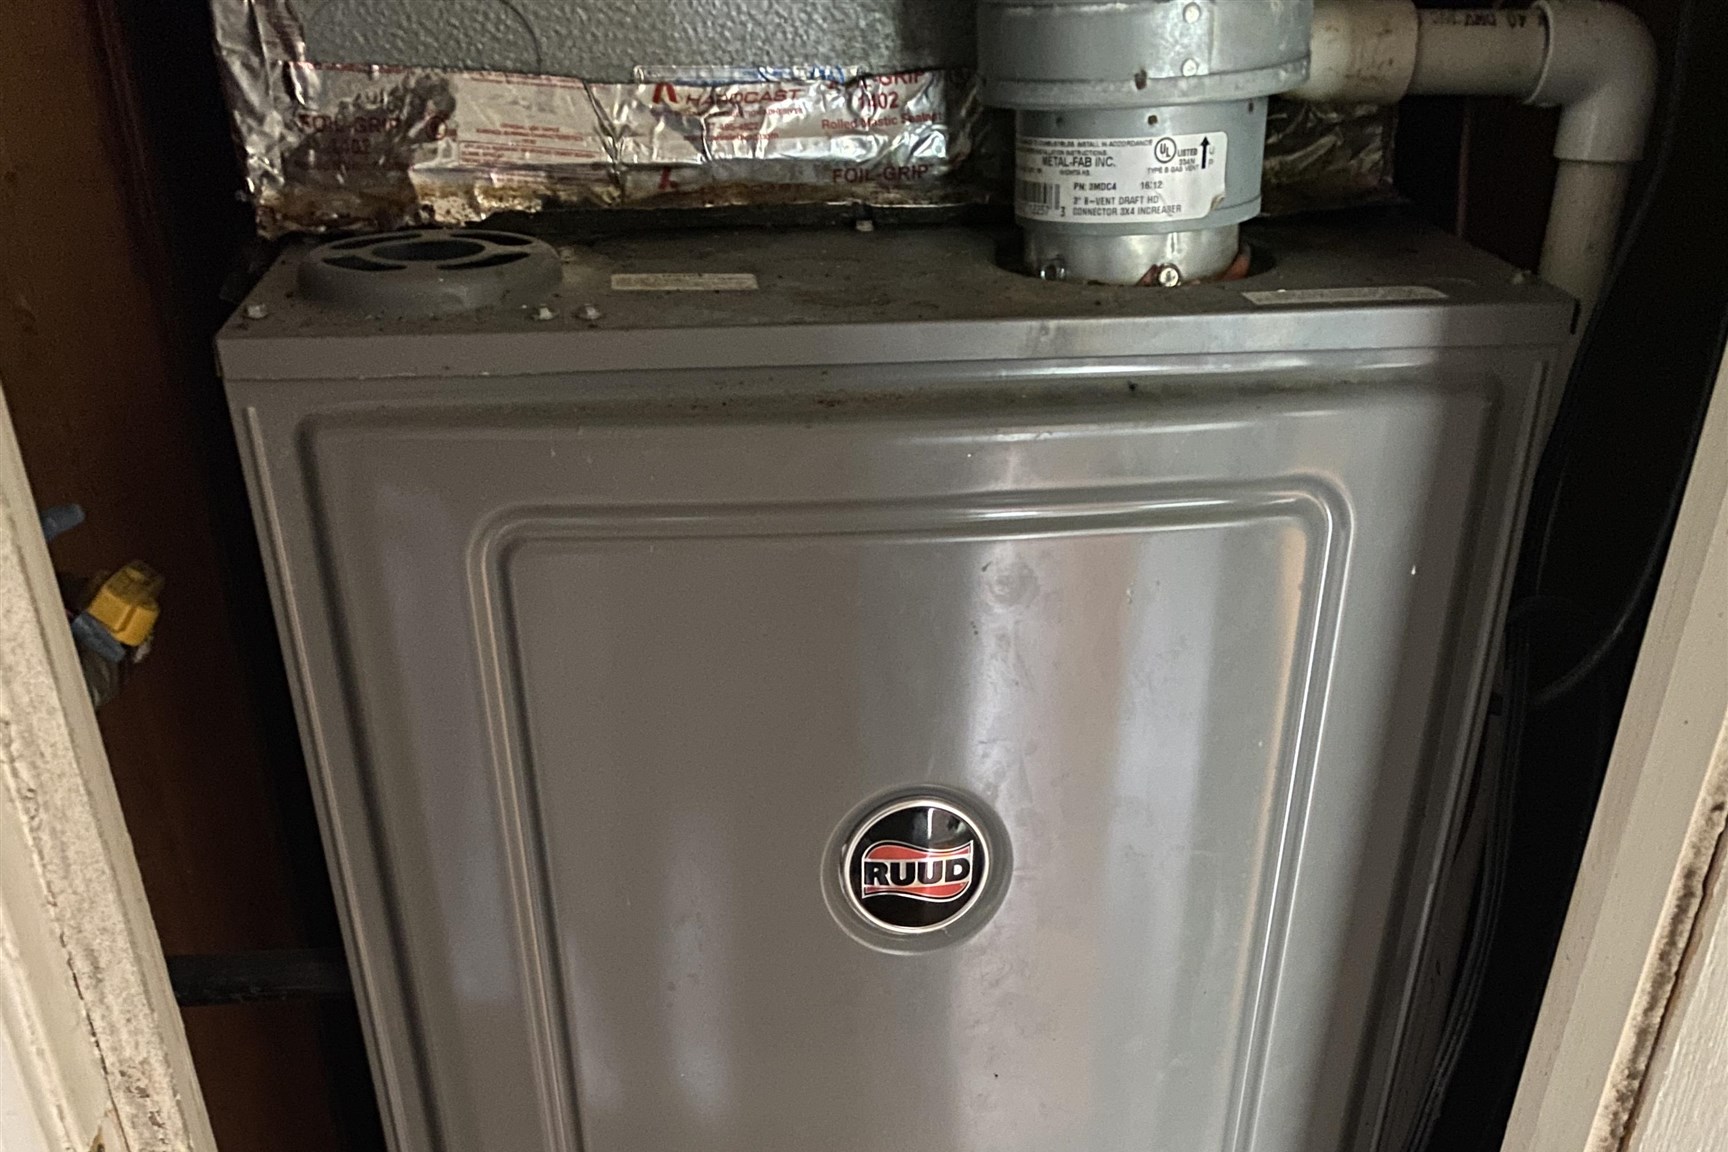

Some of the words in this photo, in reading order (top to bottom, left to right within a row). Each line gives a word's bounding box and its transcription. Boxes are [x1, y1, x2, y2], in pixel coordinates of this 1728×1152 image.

[822, 118, 857, 130] Rolled
[1177, 147, 1198, 158] LISTED
[1042, 156, 1092, 168] METAL-FAB
[1095, 156, 1116, 168] INC.
[832, 164, 929, 184] FOIL-GRIP
[1118, 195, 1144, 205] DRAFT
[1073, 206, 1118, 217] CONNECTOR
[864, 857, 971, 886] RUUD
